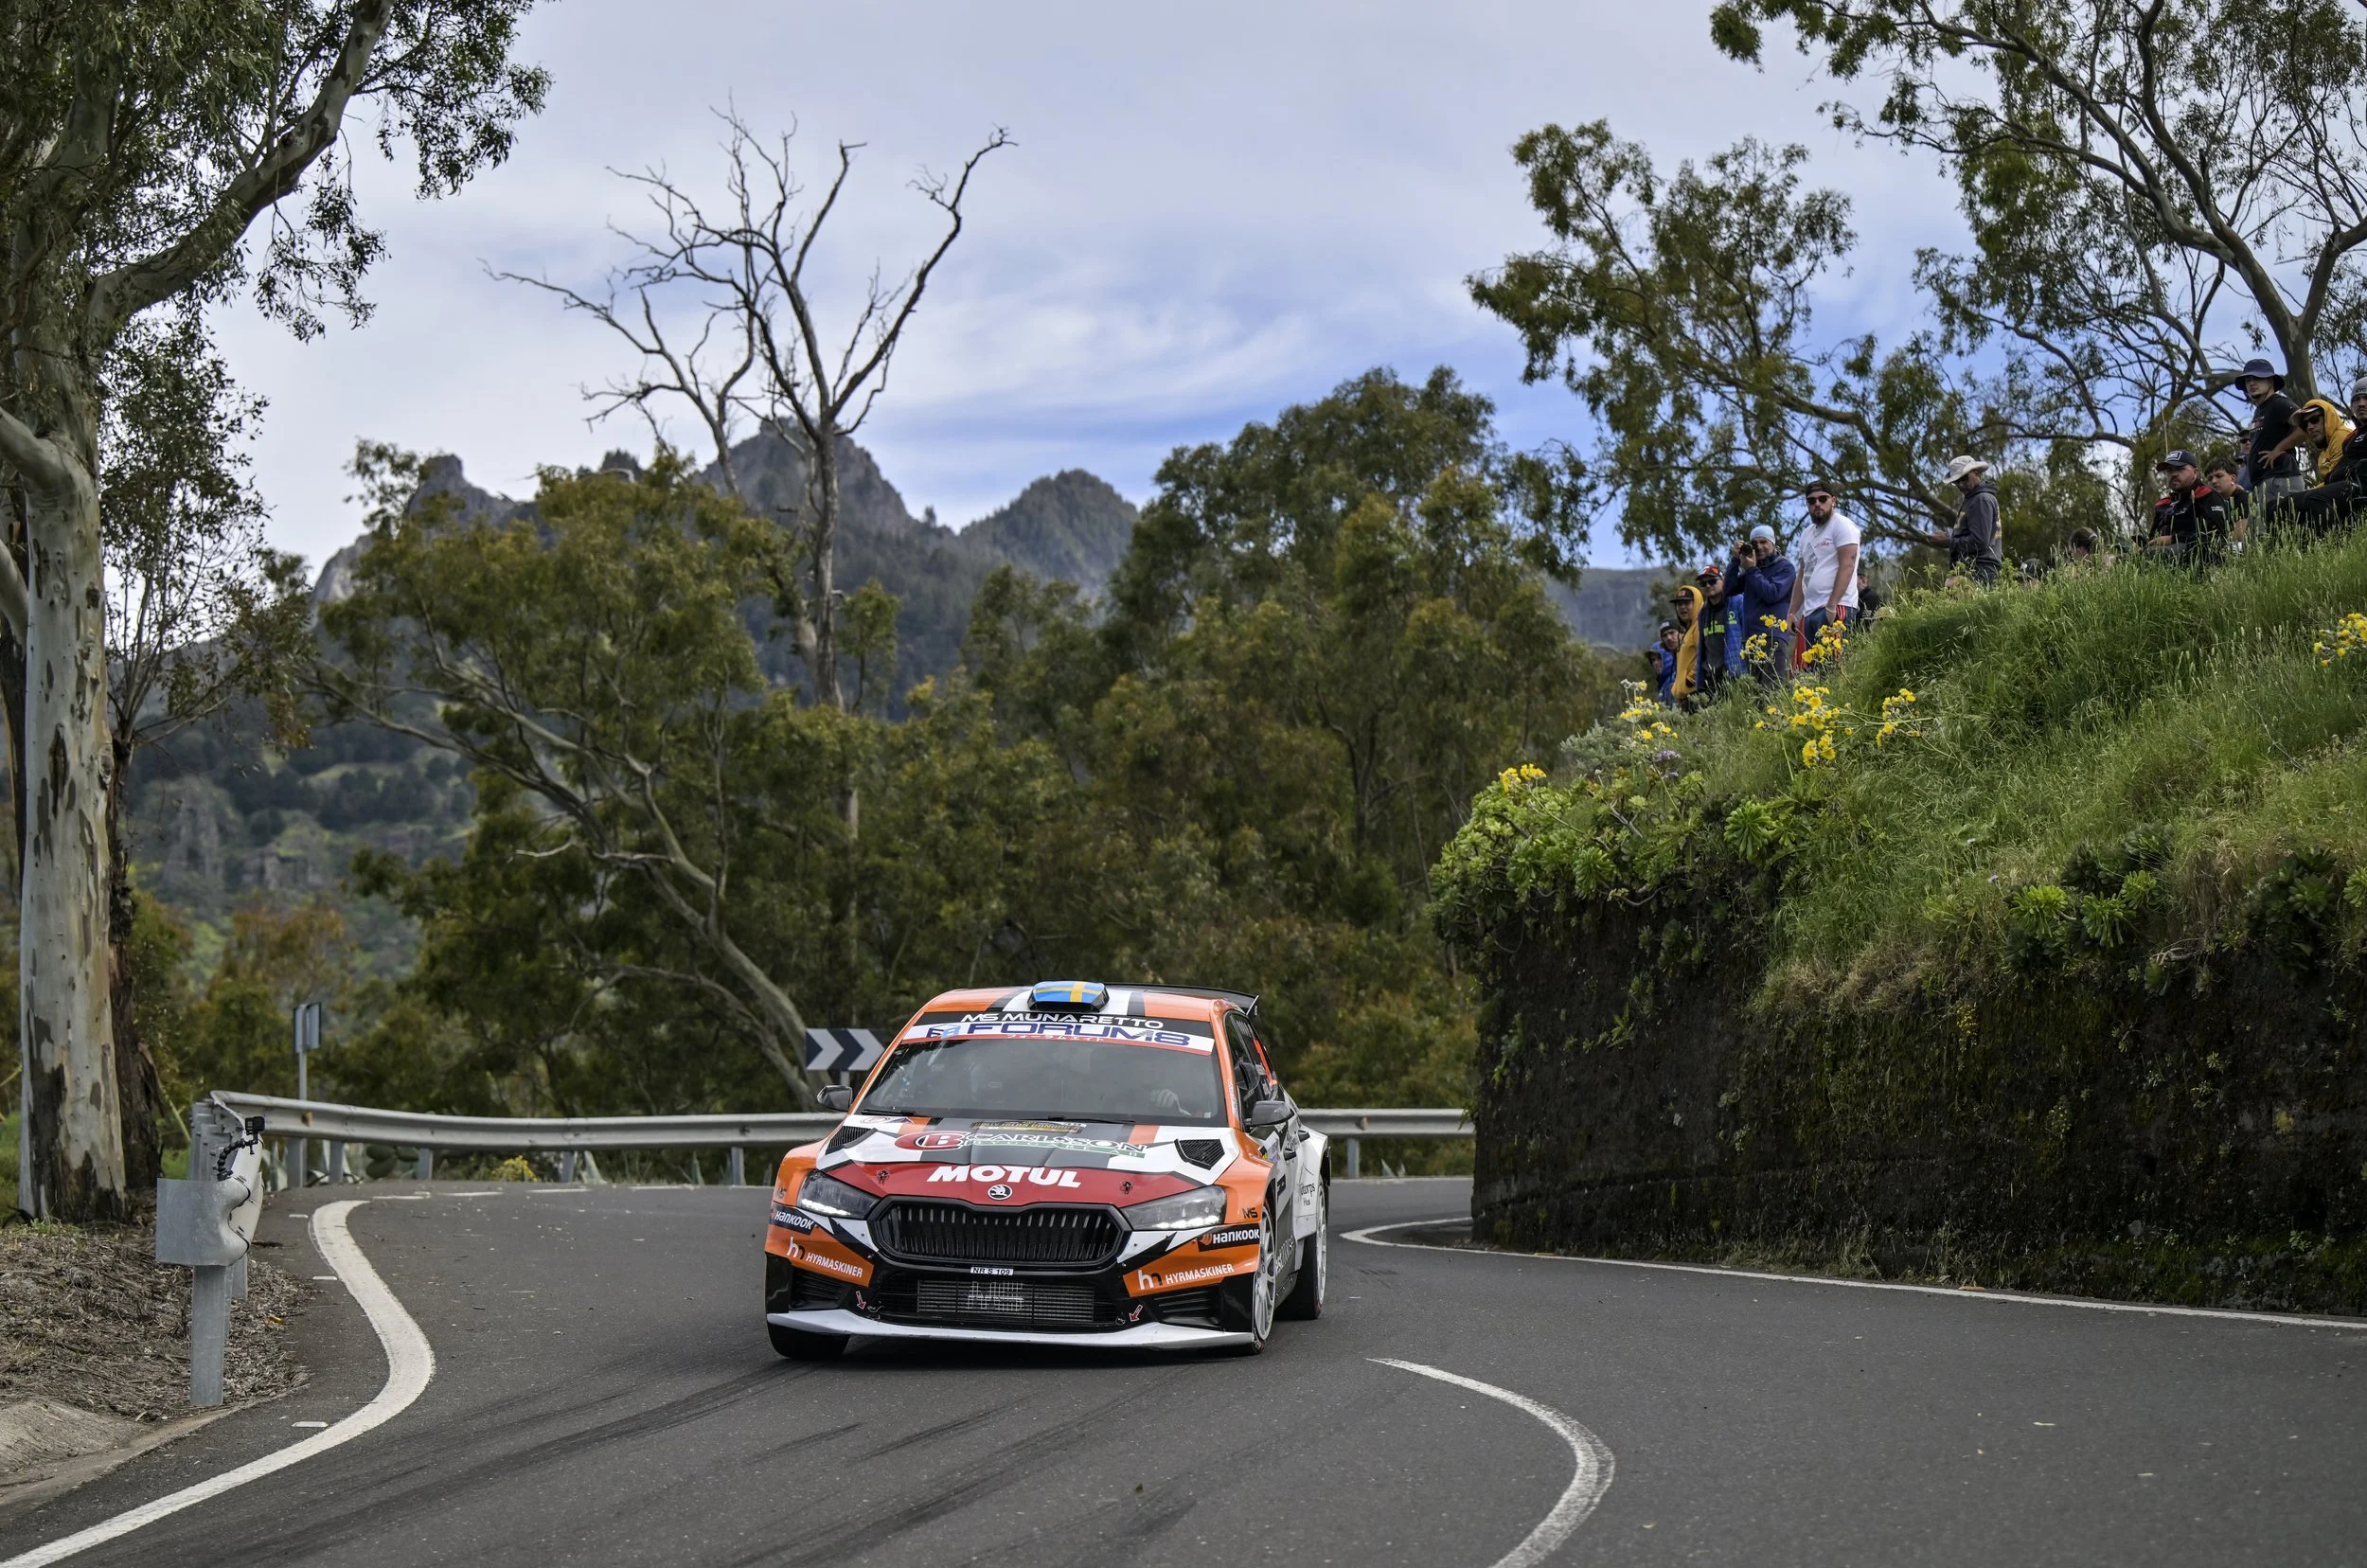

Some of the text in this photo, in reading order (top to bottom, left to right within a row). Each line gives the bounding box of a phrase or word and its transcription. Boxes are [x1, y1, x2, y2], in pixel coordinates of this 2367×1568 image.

[960, 1013, 1164, 1029] MS MUNARETTO
[968, 1023, 1190, 1046] FORUM8
[965, 1132, 1148, 1152] CARLSSON
[927, 1165, 1081, 1188] MOTUL
[1242, 1207, 1257, 1219] MS
[806, 1252, 863, 1278] HYRMASKINER
[1166, 1263, 1235, 1285] HYRMASKINER
